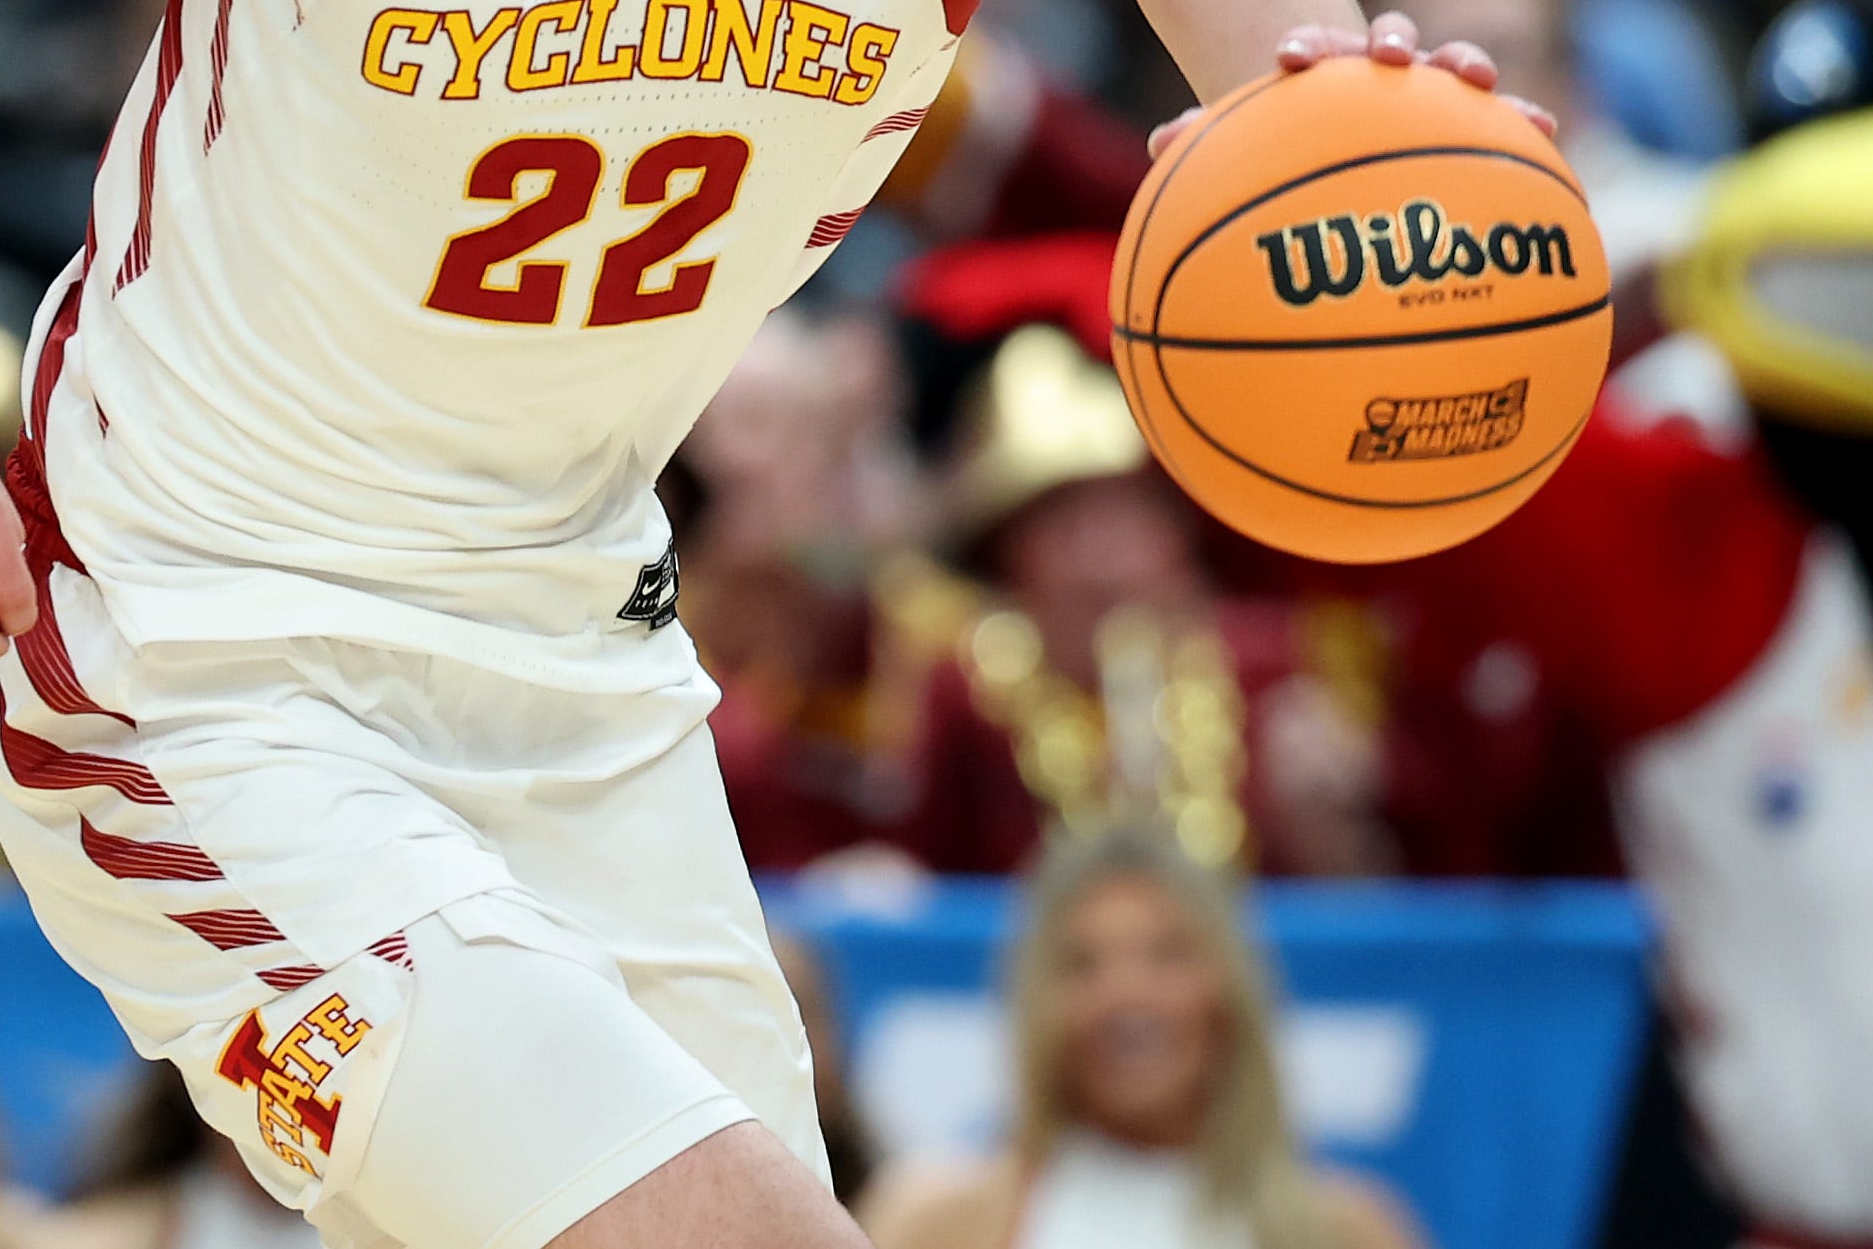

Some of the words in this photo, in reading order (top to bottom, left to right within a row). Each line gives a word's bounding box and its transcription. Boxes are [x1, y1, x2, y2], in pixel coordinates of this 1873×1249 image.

[421, 131, 753, 329] 22
[1256, 201, 1577, 306] Wilson
[1399, 292, 1445, 307] EVO
[1396, 395, 1488, 427] MARCH
[257, 992, 373, 1180] STATE
